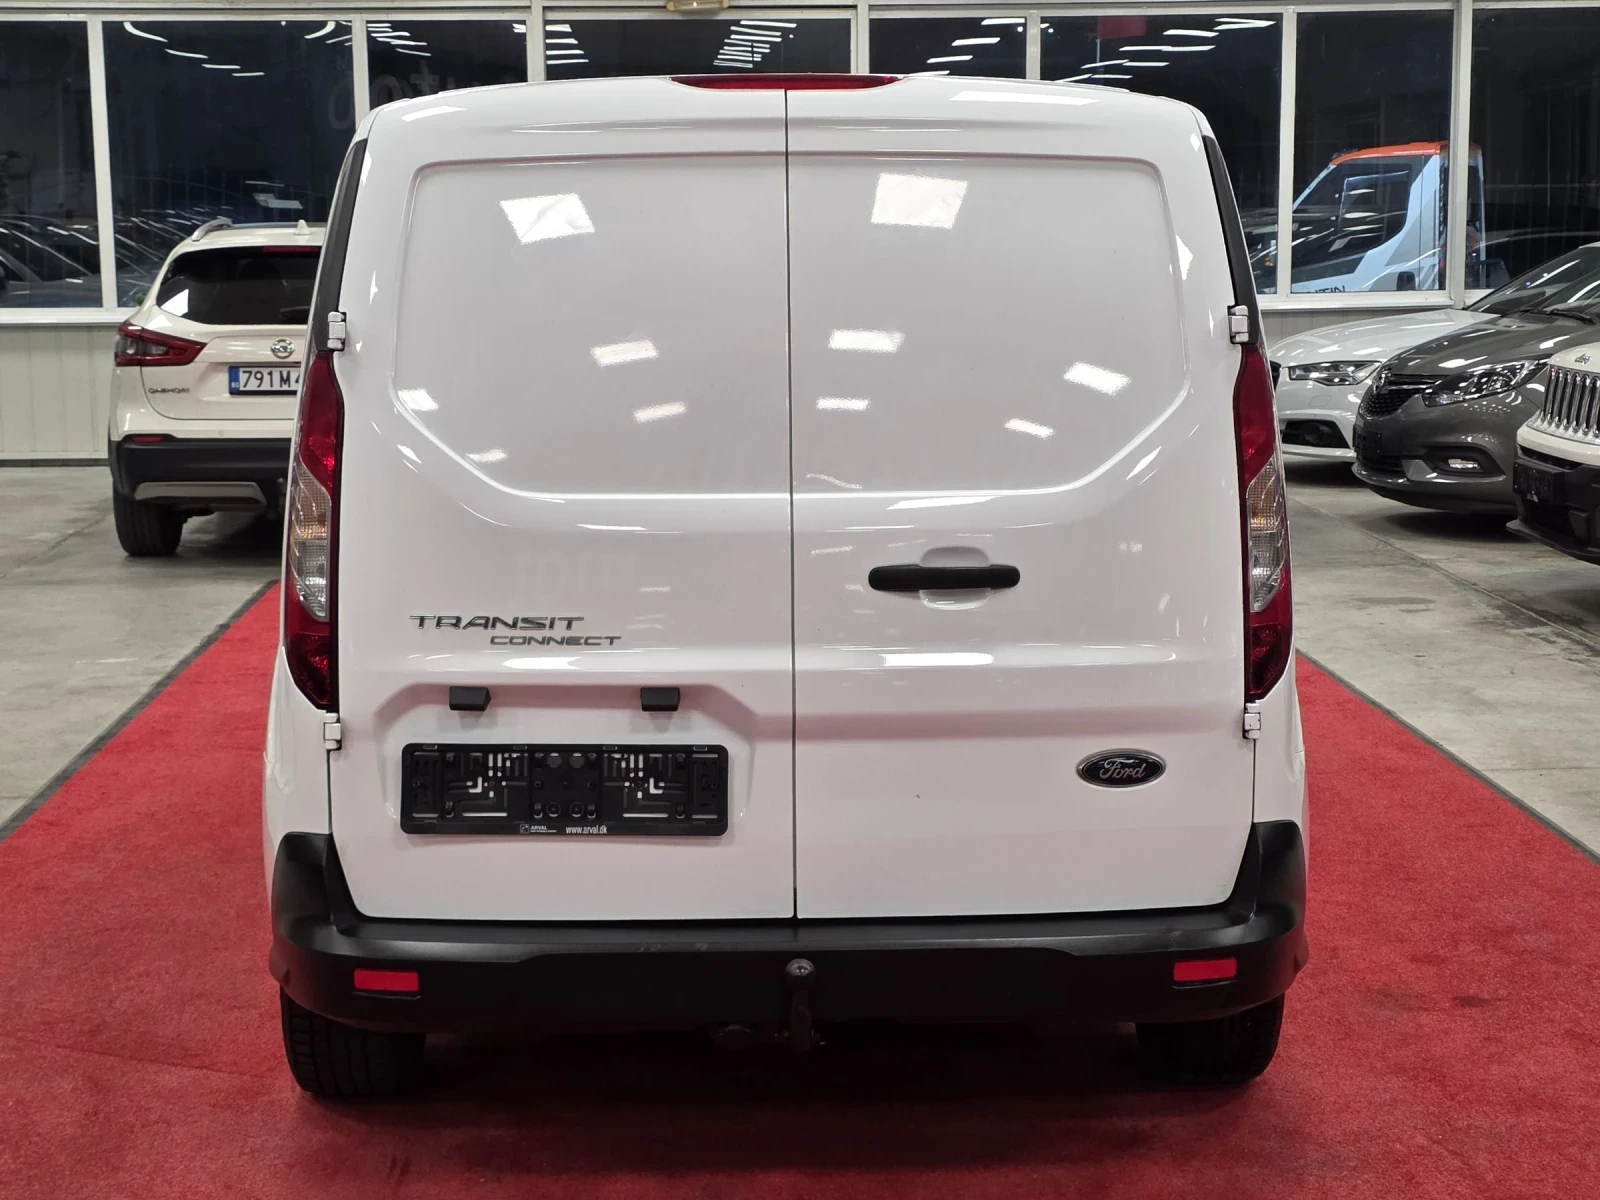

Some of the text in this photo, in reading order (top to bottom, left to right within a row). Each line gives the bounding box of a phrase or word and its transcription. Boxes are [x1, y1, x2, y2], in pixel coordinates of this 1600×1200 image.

[410, 615, 584, 631] TRANSIT
[490, 635, 621, 646] CONNECT
[1099, 757, 1146, 779] Ford
[565, 824, 608, 834] www.arval.dk
